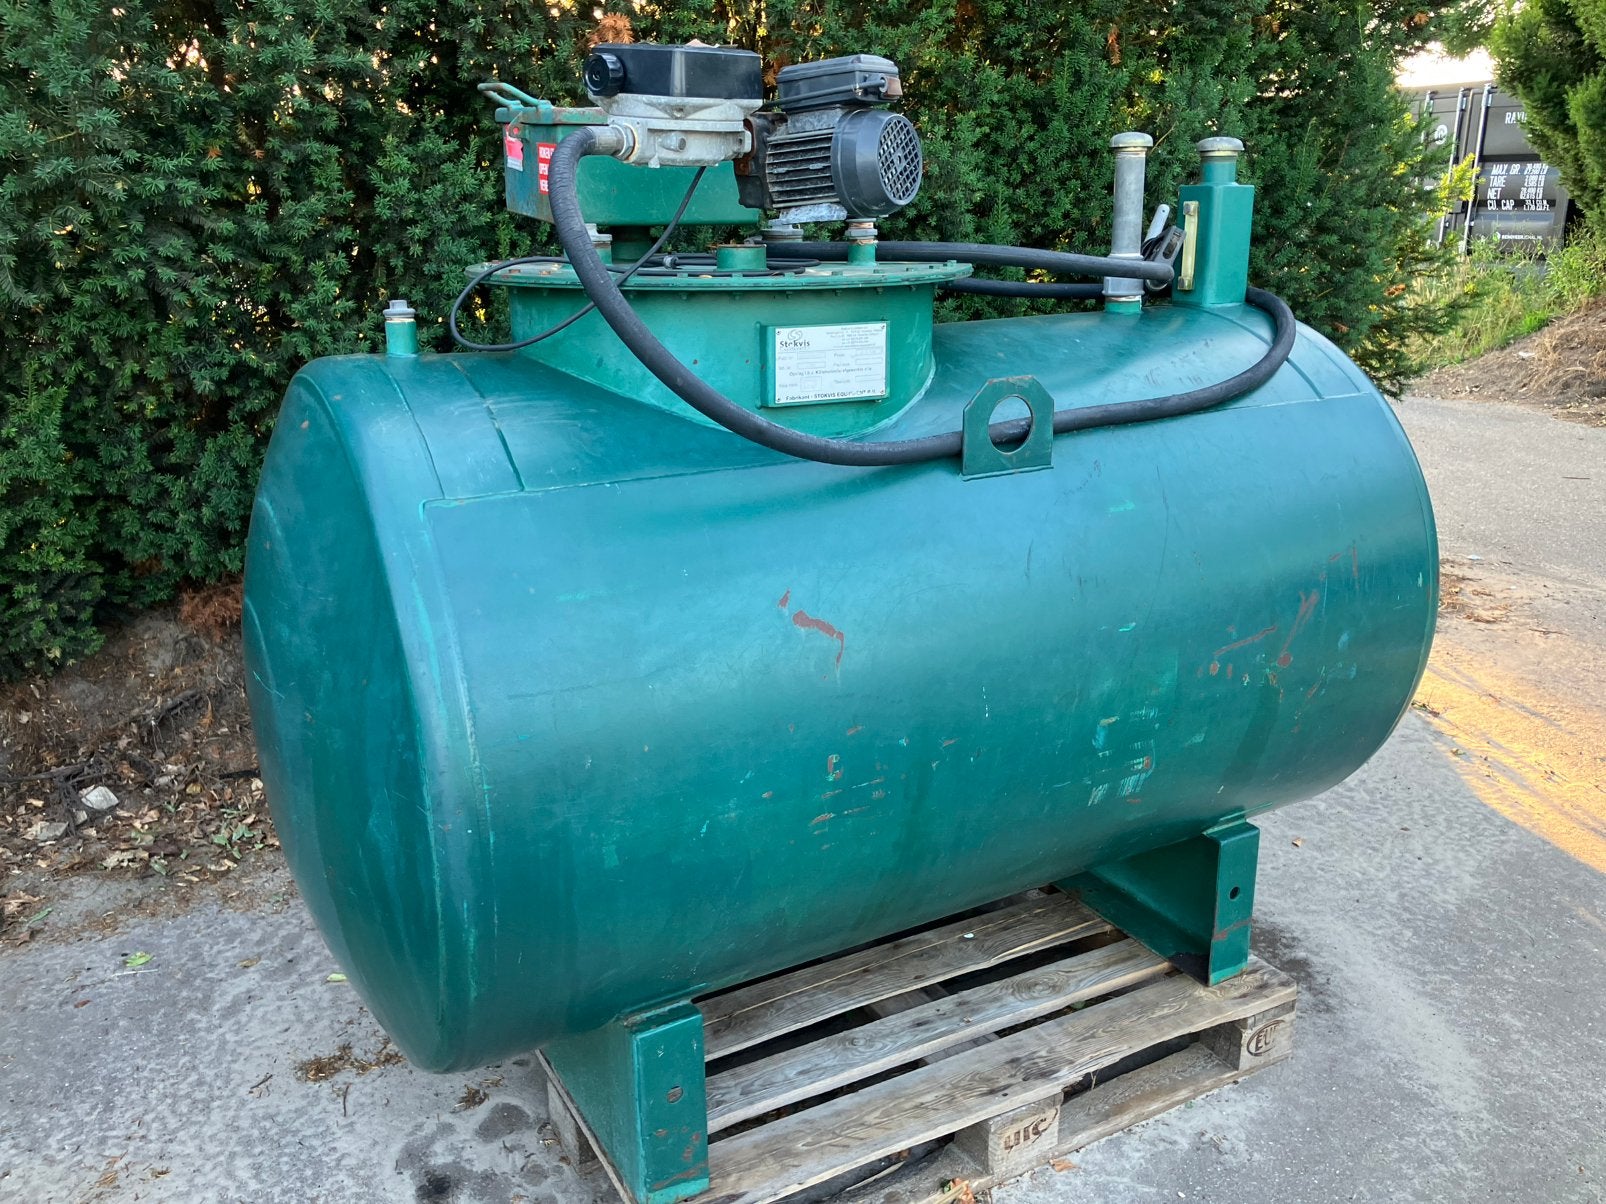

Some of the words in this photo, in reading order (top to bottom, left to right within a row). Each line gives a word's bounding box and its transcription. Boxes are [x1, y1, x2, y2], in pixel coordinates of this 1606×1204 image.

[1491, 164, 1508, 175] MAX.
[1509, 164, 1521, 175] GR.
[1489, 176, 1507, 187] TARE
[1487, 188, 1502, 199] NET
[1487, 200, 1499, 211] CU.
[1501, 200, 1517, 211] CAP.
